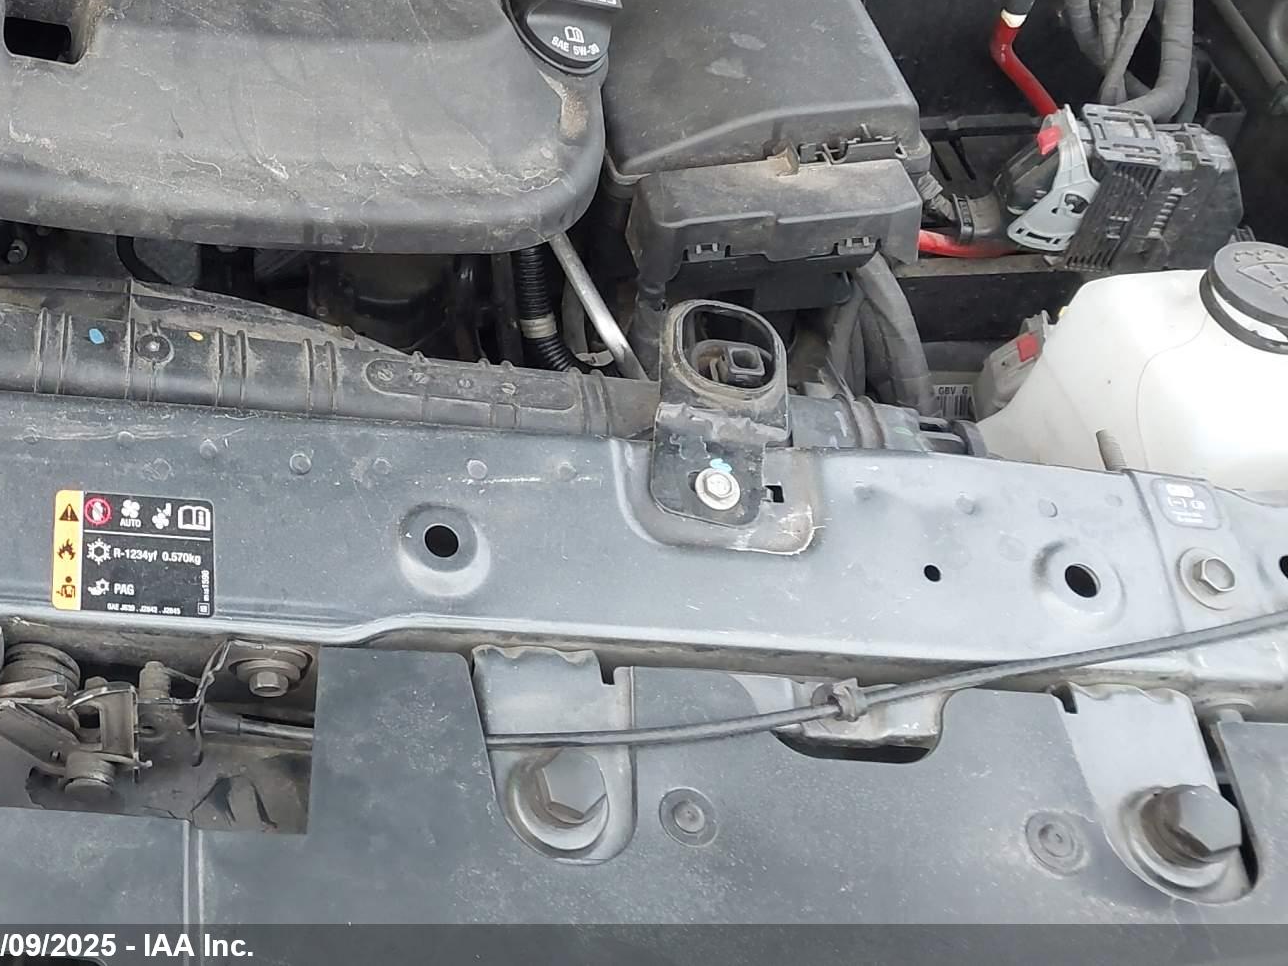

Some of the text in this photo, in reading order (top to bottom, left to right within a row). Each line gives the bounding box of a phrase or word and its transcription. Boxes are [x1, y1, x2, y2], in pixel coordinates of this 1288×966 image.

[119, 518, 142, 528] AUTO
[113, 547, 202, 566] R-1234yf 0.570kg
[113, 583, 135, 596] PAG
